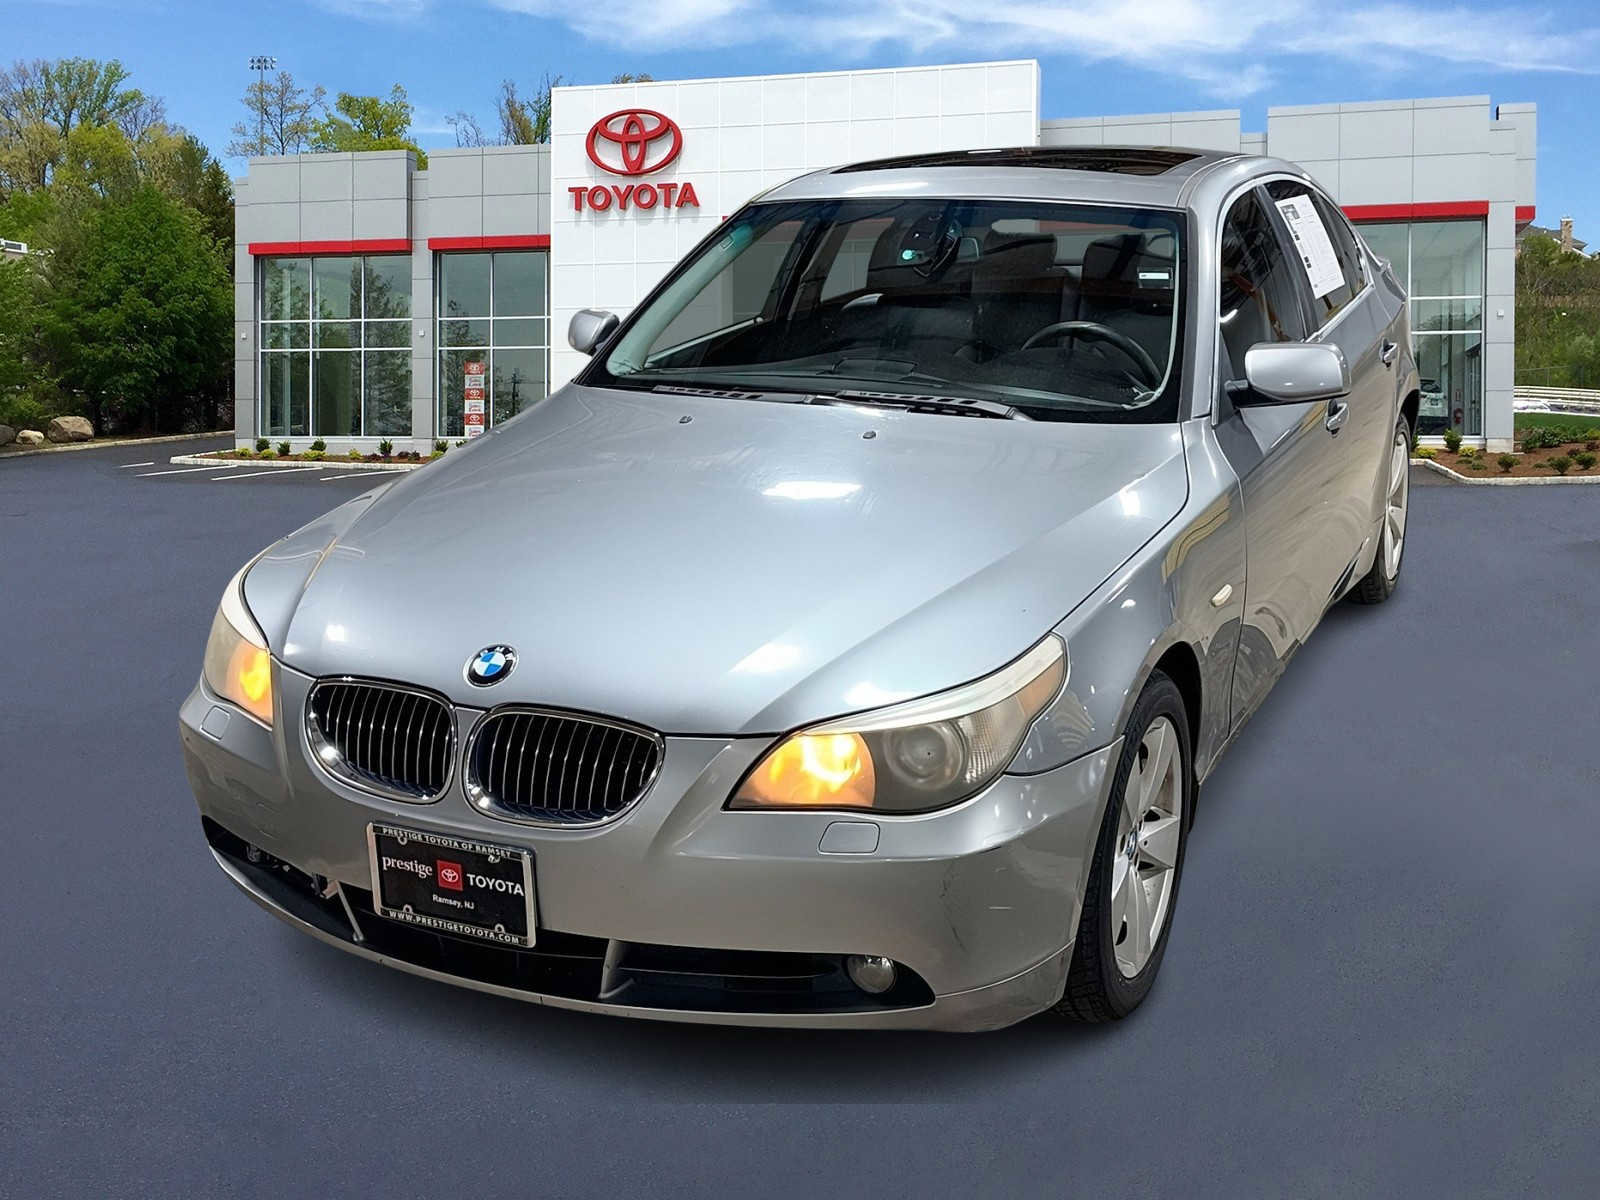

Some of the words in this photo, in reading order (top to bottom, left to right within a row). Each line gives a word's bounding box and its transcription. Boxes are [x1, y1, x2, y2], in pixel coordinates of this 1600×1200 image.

[568, 182, 700, 212] TOYOTA
[383, 827, 423, 841] PRESTIGE
[424, 835, 459, 848] TOYOTA
[461, 842, 473, 852] OF
[475, 845, 511, 857] RAMSEY
[382, 856, 433, 879] prestige
[466, 873, 525, 897] TOYOTA
[432, 894, 463, 909] Ramsey,
[389, 910, 519, 944] WWW.PRESTIGETOYOTA.COM
